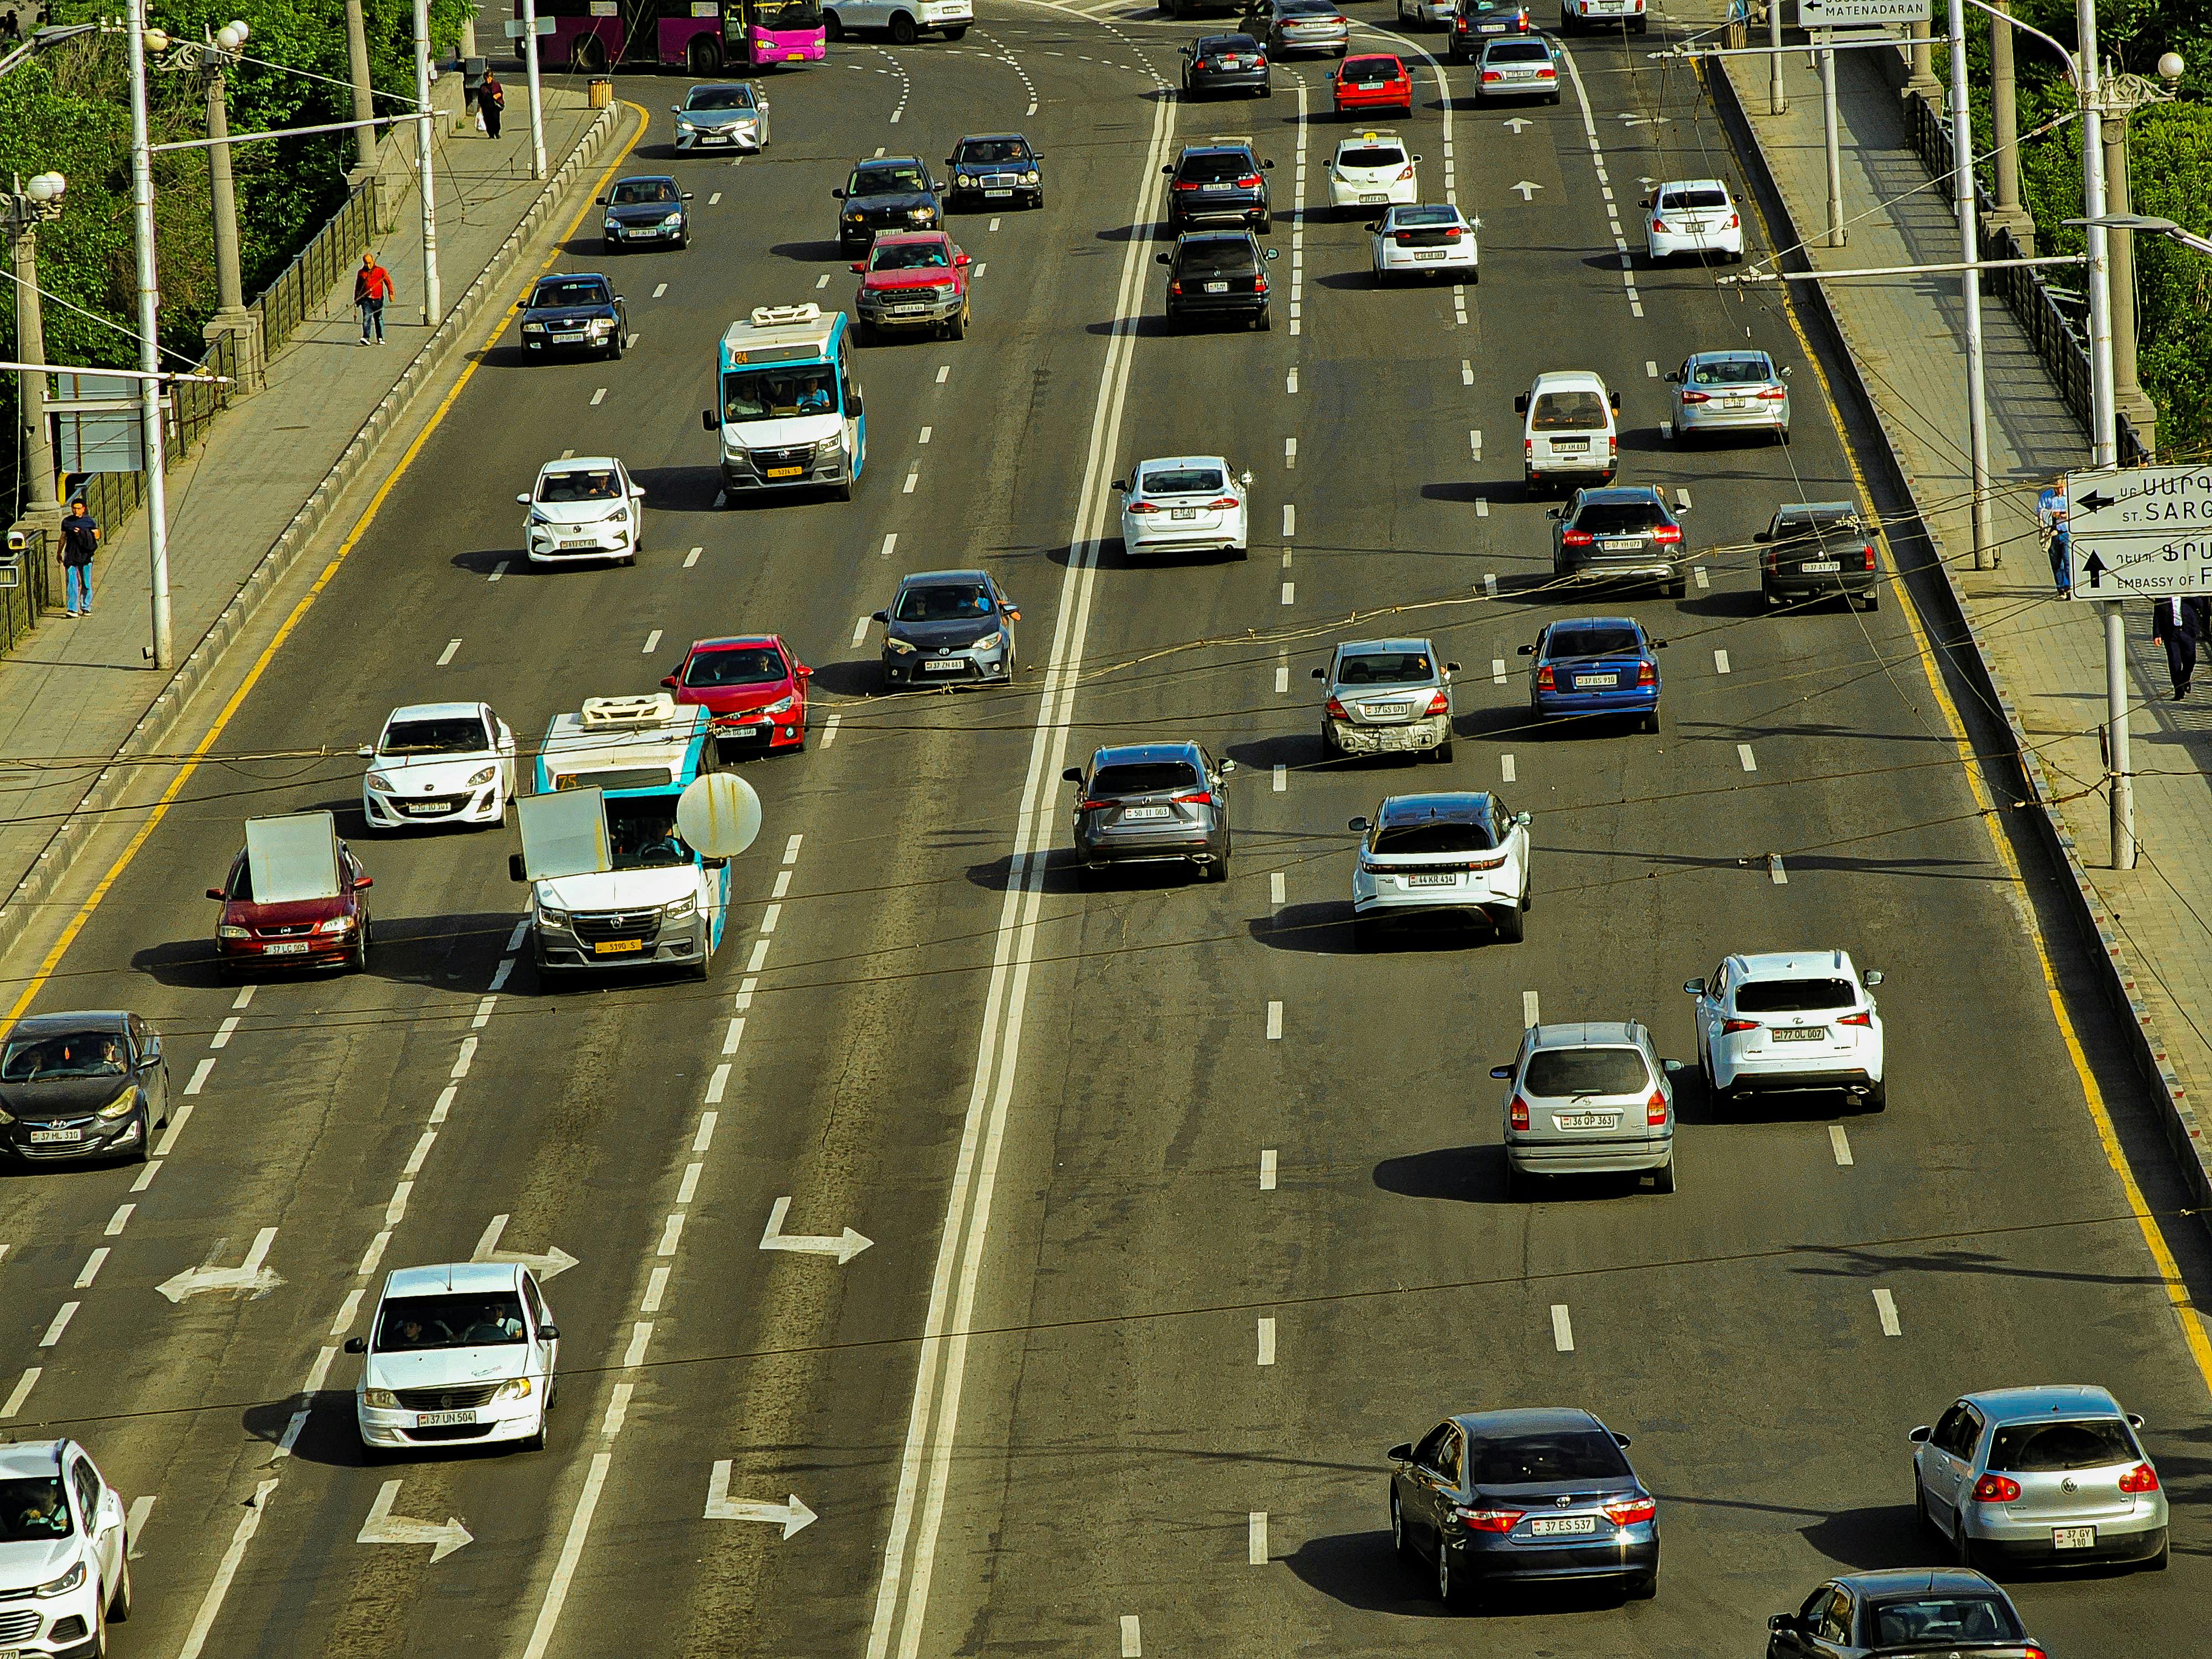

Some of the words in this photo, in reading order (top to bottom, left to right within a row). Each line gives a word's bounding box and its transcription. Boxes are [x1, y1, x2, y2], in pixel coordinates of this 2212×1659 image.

[1825, 3, 1923, 16] MATENADARAN
[736, 352, 749, 363] 24
[2122, 512, 2142, 522] ST.
[2146, 500, 2212, 521] SARG
[2117, 577, 2174, 588] EMBASSY
[2179, 576, 2195, 586] OF
[1784, 1031, 1793, 1039] 77
[1794, 1030, 1806, 1039] OL
[1808, 1029, 1821, 1038] 007
[1573, 1117, 1582, 1126] 36
[1598, 1116, 1611, 1125] 363
[64, 1131, 78, 1139] 310
[430, 1415, 440, 1425] 37
[442, 1414, 455, 1423] UN
[457, 1413, 472, 1423] 504
[1545, 1522, 1556, 1531] 37
[1559, 1521, 1572, 1531] ES
[1575, 1520, 1590, 1530] 537
[2067, 1530, 2077, 1538] 37
[2080, 1529, 2090, 1537] GY
[2072, 1538, 2086, 1547] 180
